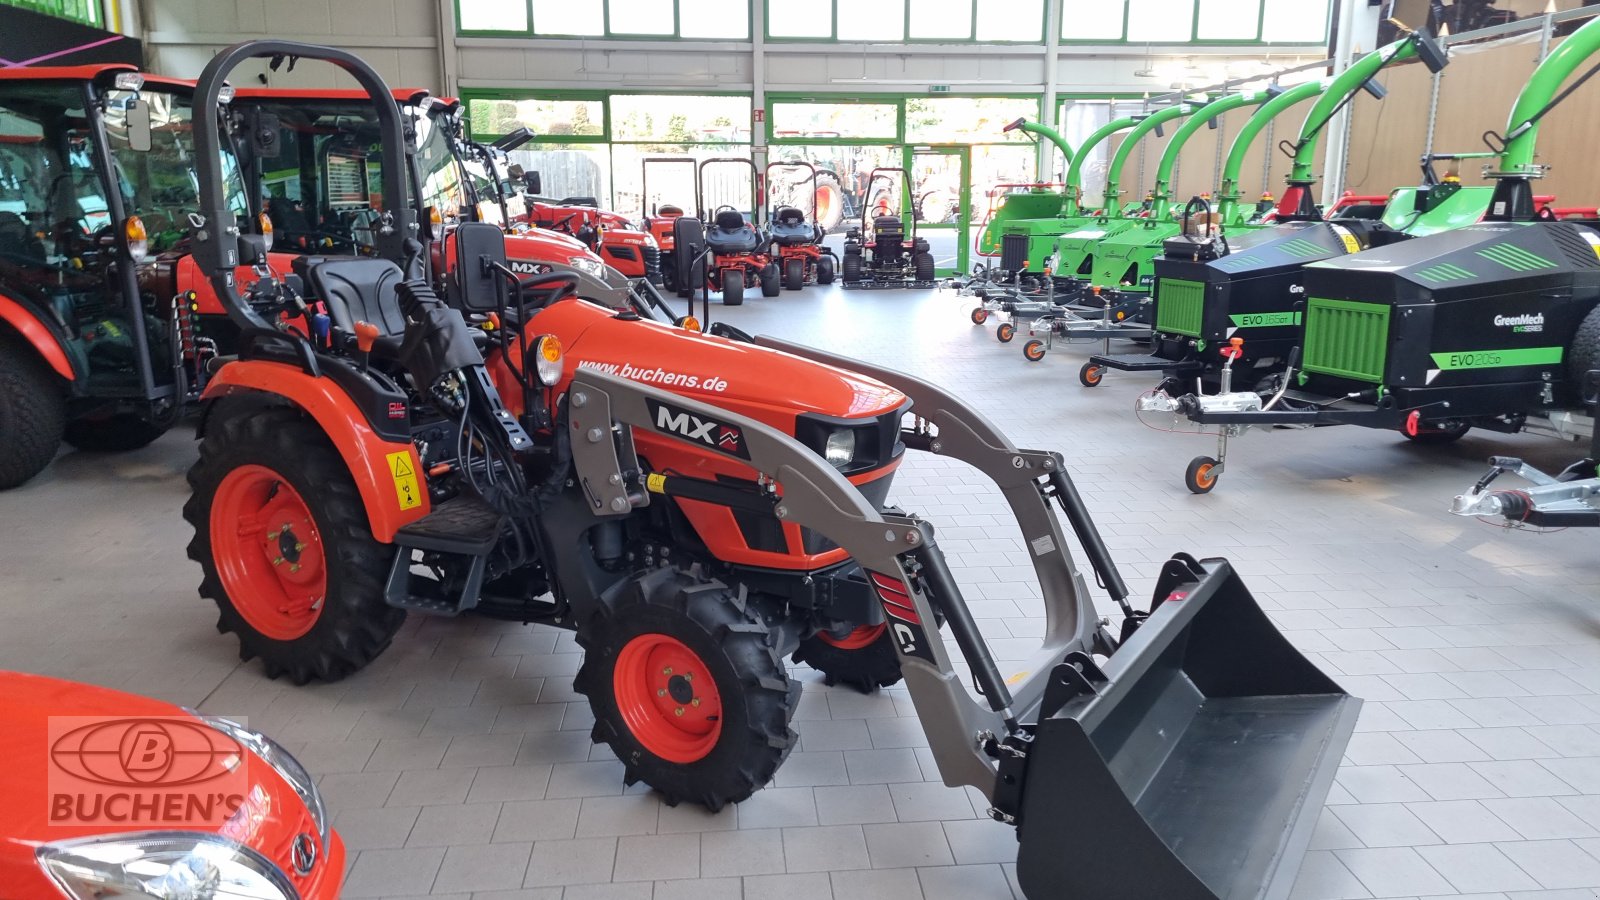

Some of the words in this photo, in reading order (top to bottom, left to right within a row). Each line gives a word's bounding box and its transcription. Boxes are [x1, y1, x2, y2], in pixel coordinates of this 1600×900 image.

[511, 262, 540, 274] MX
[1242, 315, 1263, 325] EVO
[1493, 312, 1544, 326] GreenMech
[1450, 354, 1474, 366] EVO
[578, 360, 728, 392] www.buchens.de
[656, 405, 718, 445] MX
[893, 623, 916, 653] C1
